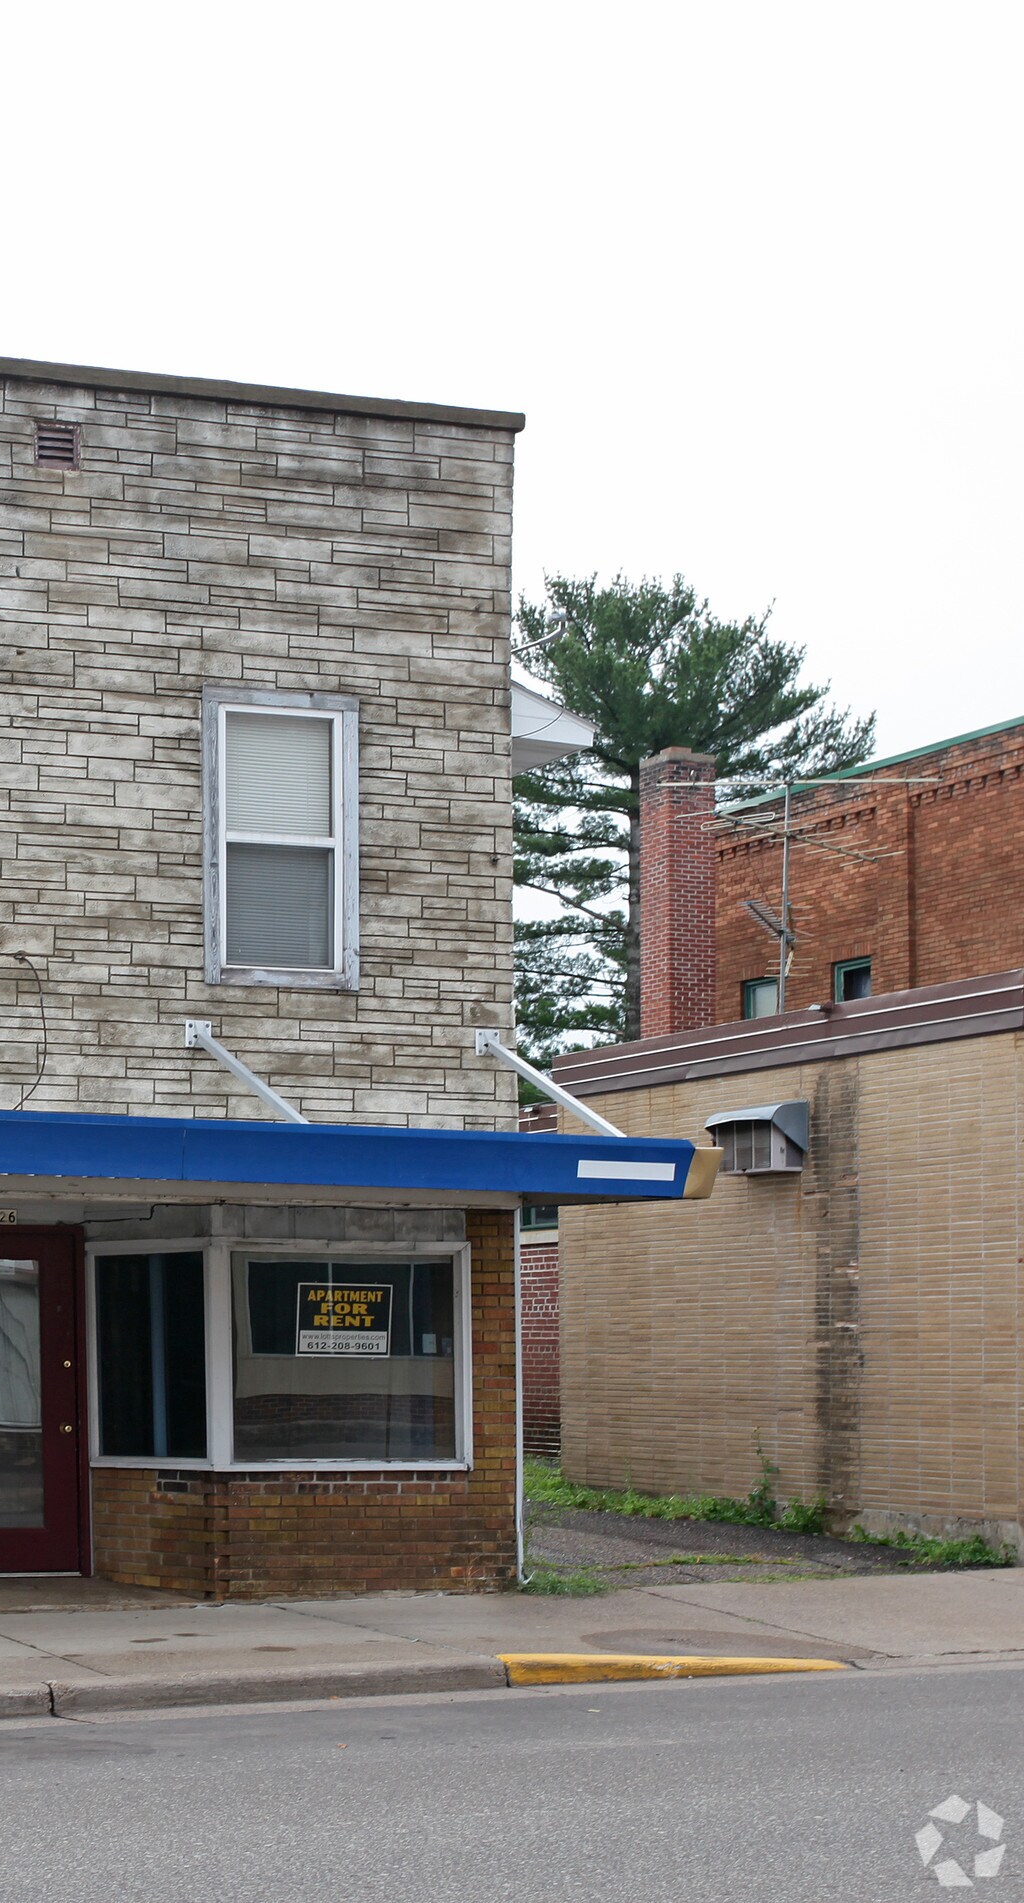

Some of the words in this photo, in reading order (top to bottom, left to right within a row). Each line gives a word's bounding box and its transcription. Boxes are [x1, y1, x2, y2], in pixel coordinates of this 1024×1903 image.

[307, 1289, 383, 1302] APARTMENT
[320, 1302, 368, 1315] FOR
[313, 1315, 375, 1327] RENT
[307, 1342, 380, 1350] 612-208-9601
